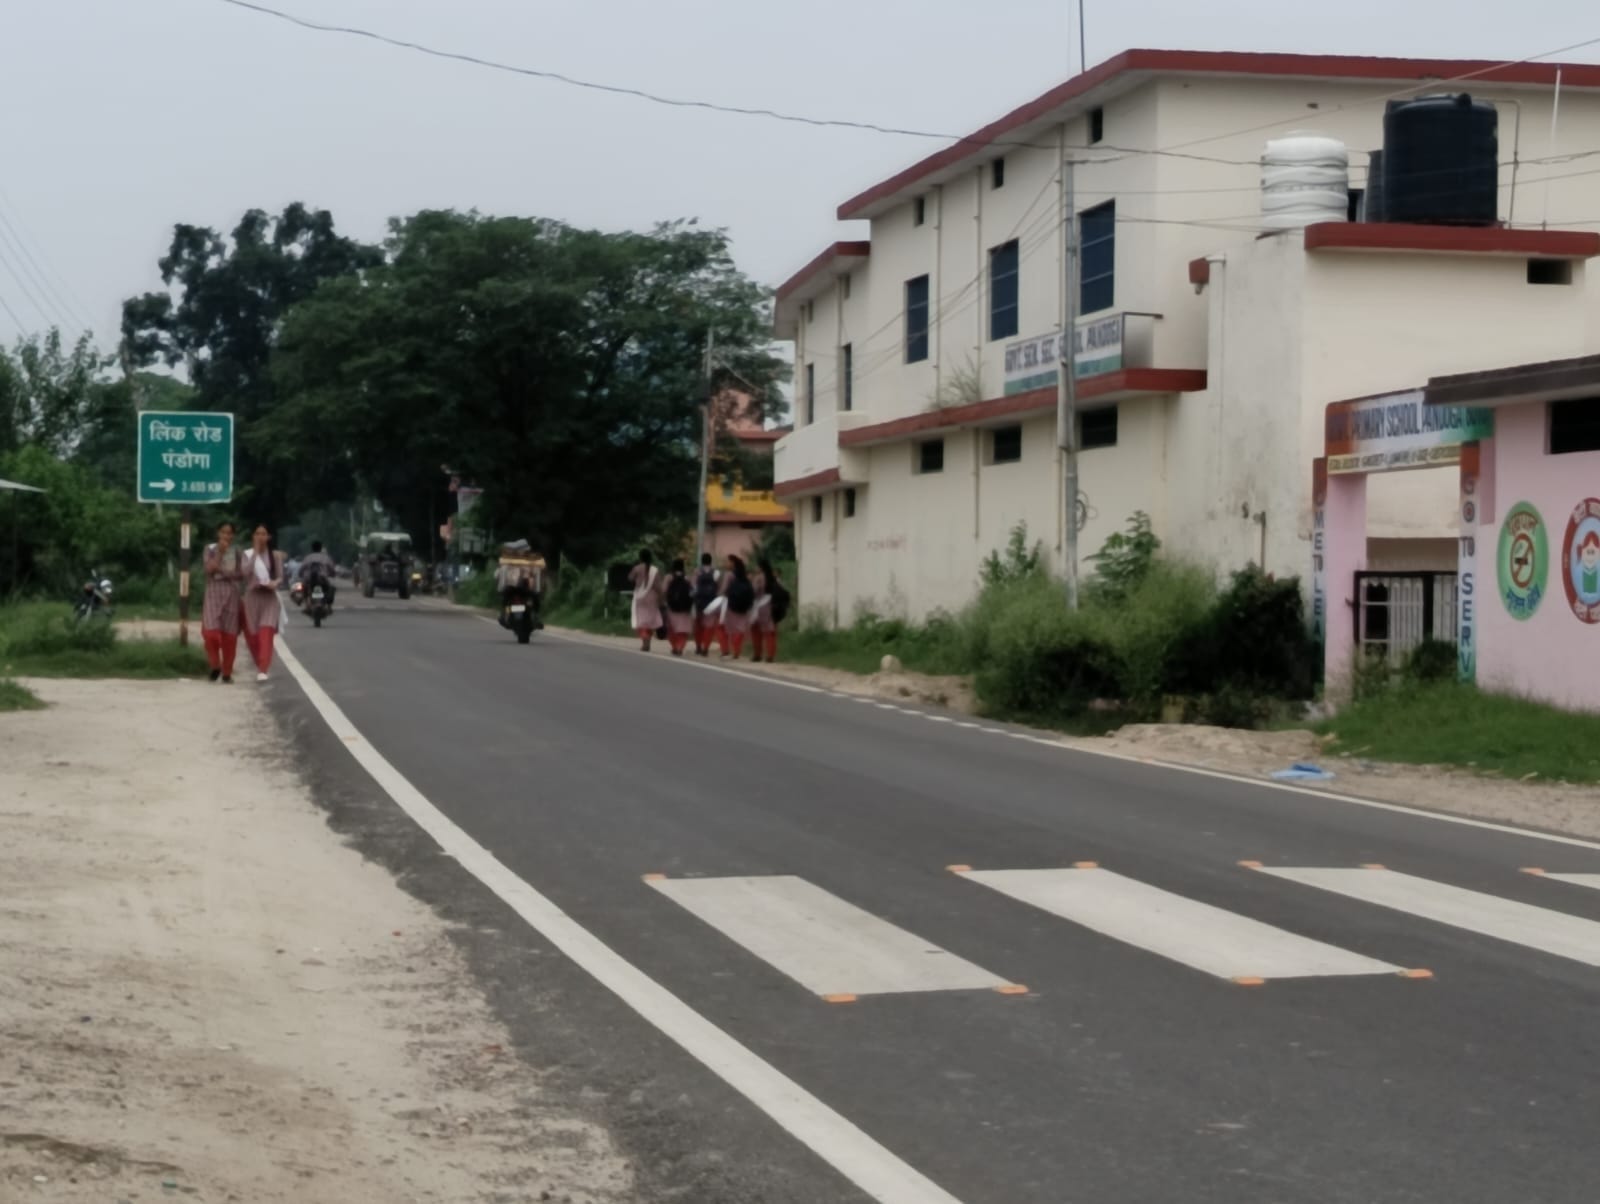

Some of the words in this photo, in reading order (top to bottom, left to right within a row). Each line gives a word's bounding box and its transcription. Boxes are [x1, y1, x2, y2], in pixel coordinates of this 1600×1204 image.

[1387, 402, 1420, 437] SCHOOL
[149, 420, 186, 441] लिंक
[191, 421, 222, 442] रोड
[161, 448, 210, 469] पंडोगा
[1459, 536, 1475, 558] TO
